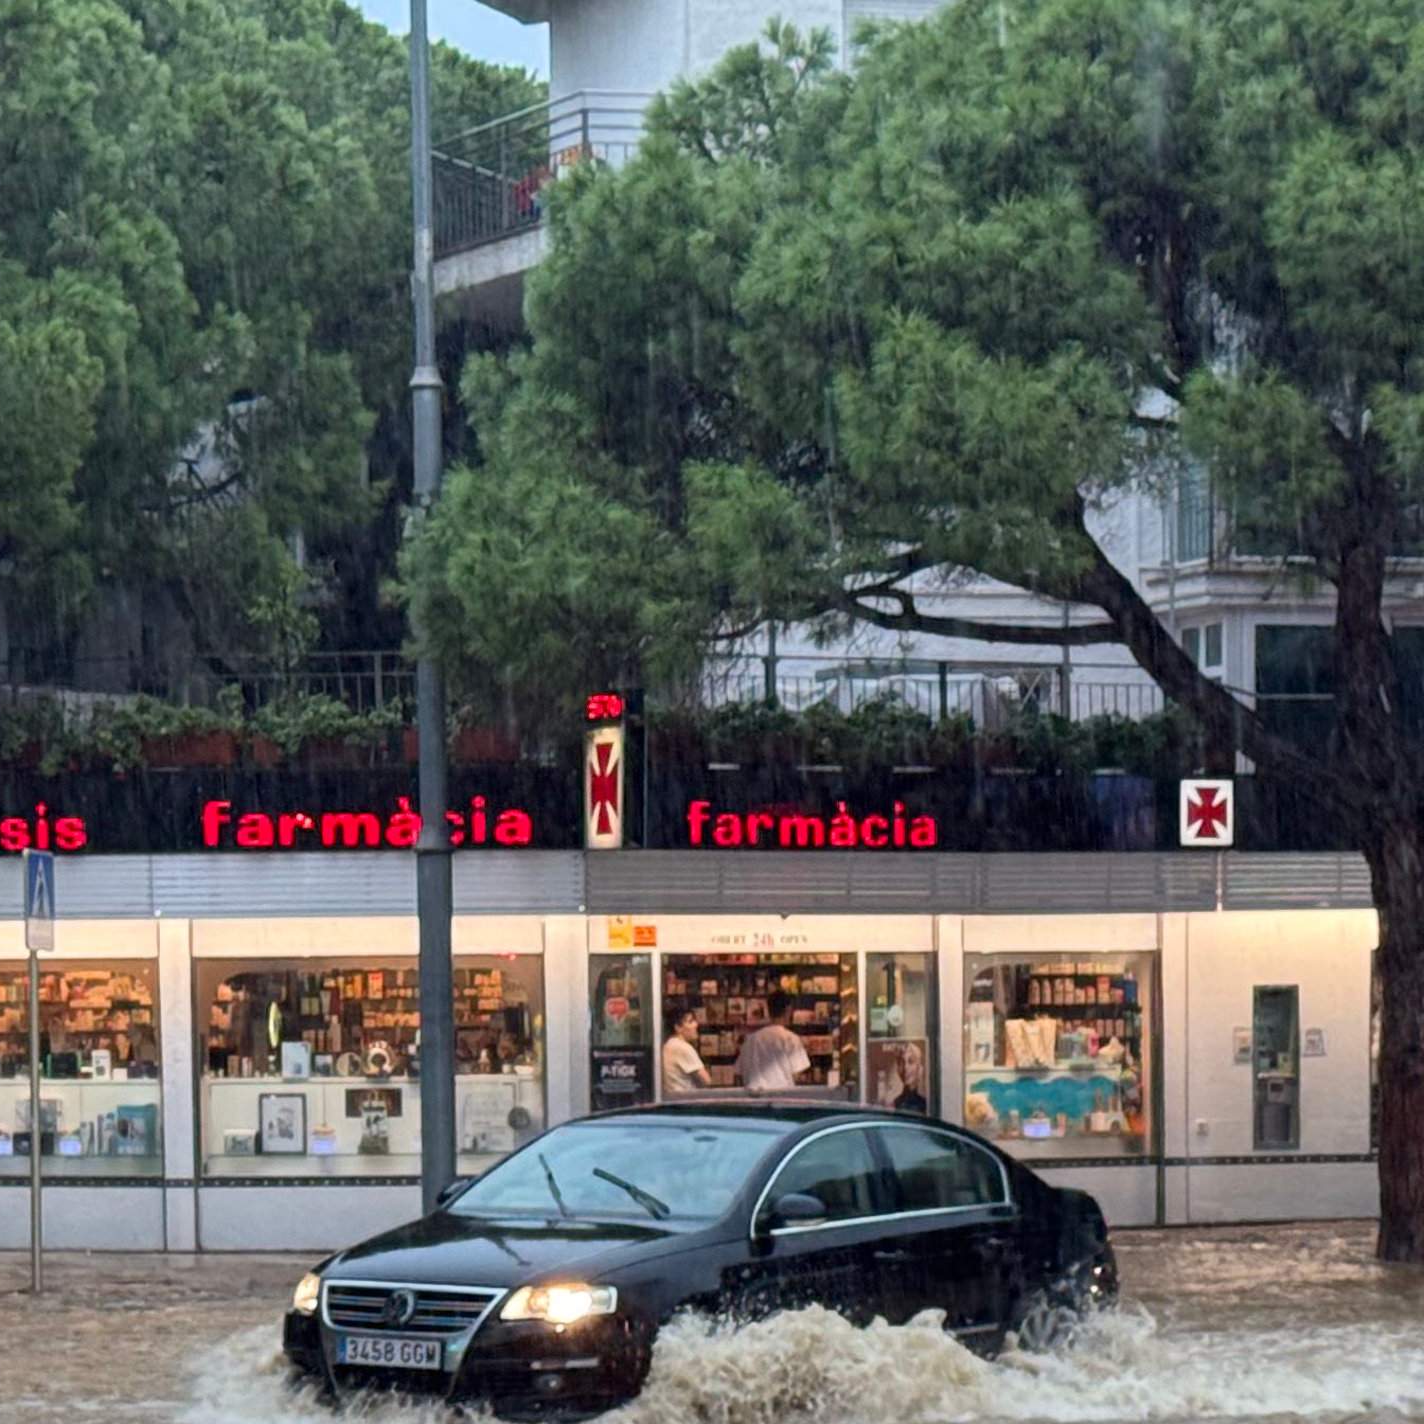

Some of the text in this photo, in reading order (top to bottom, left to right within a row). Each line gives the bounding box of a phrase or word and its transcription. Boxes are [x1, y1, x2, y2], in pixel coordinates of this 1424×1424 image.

[687, 800, 937, 847] farmàcia
[348, 1339, 436, 1363] 3458 GGW
